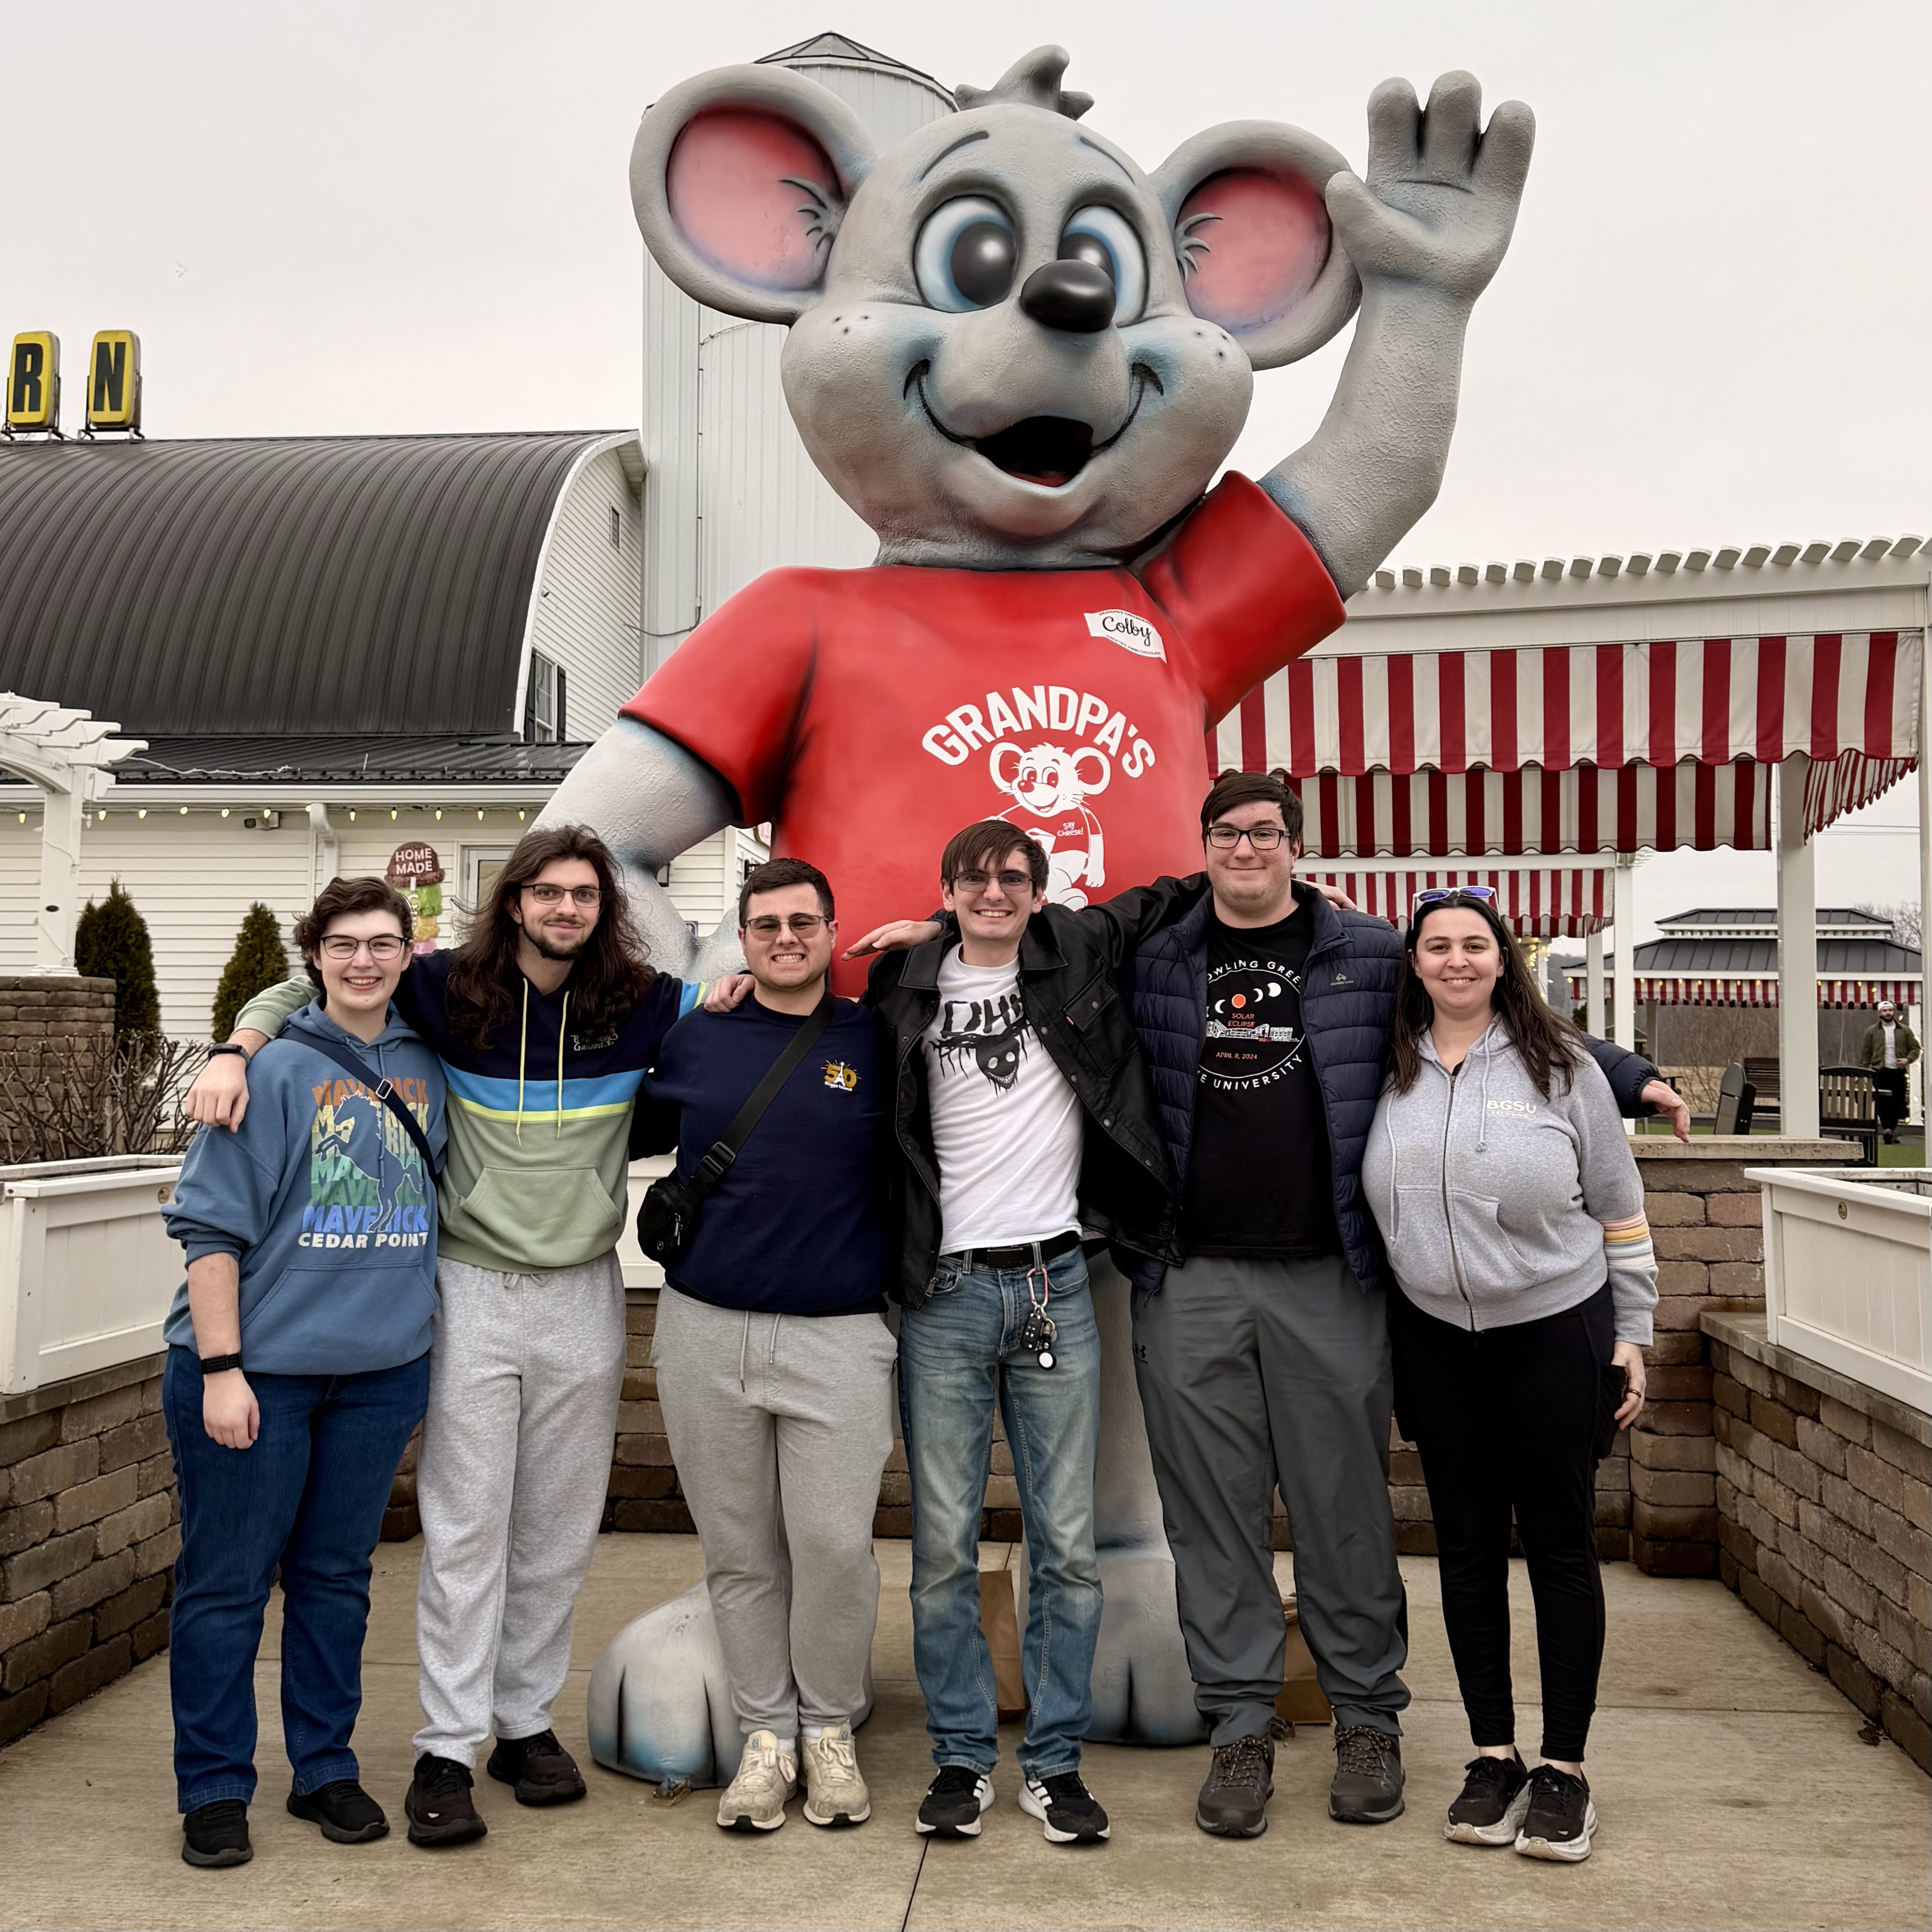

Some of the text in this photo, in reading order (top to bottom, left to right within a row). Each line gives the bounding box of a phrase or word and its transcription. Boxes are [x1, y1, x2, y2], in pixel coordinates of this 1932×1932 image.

[1102, 616, 1151, 646] Colby
[922, 685, 1156, 778] GRANDPA'S
[395, 848, 432, 862] HOME
[396, 860, 433, 875] MADE
[1207, 959, 1302, 987] OWLING GREE
[1214, 1054, 1302, 1090] UNIVERSITY
[1487, 1100, 1536, 1114] BGSU
[302, 1205, 429, 1234] MAVEICK
[298, 1231, 428, 1249] CEDAR POINT
